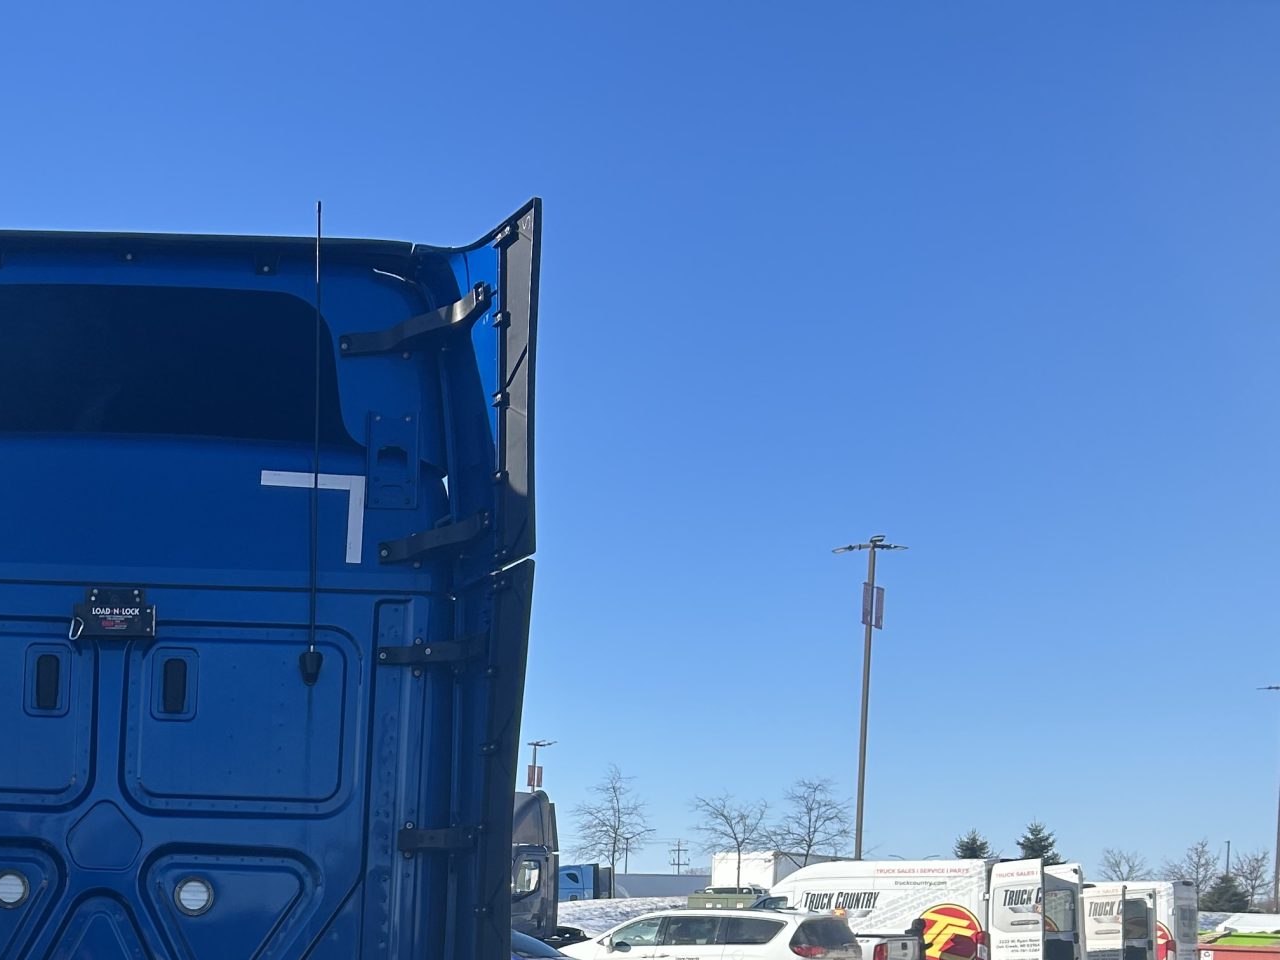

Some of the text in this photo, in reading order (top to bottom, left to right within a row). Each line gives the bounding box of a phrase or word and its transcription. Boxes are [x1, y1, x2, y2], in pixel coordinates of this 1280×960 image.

[804, 891, 880, 911] TRUCK COUNTRY
[1003, 889, 1034, 907] TRUCK
[1088, 901, 1116, 917] TRUCK
